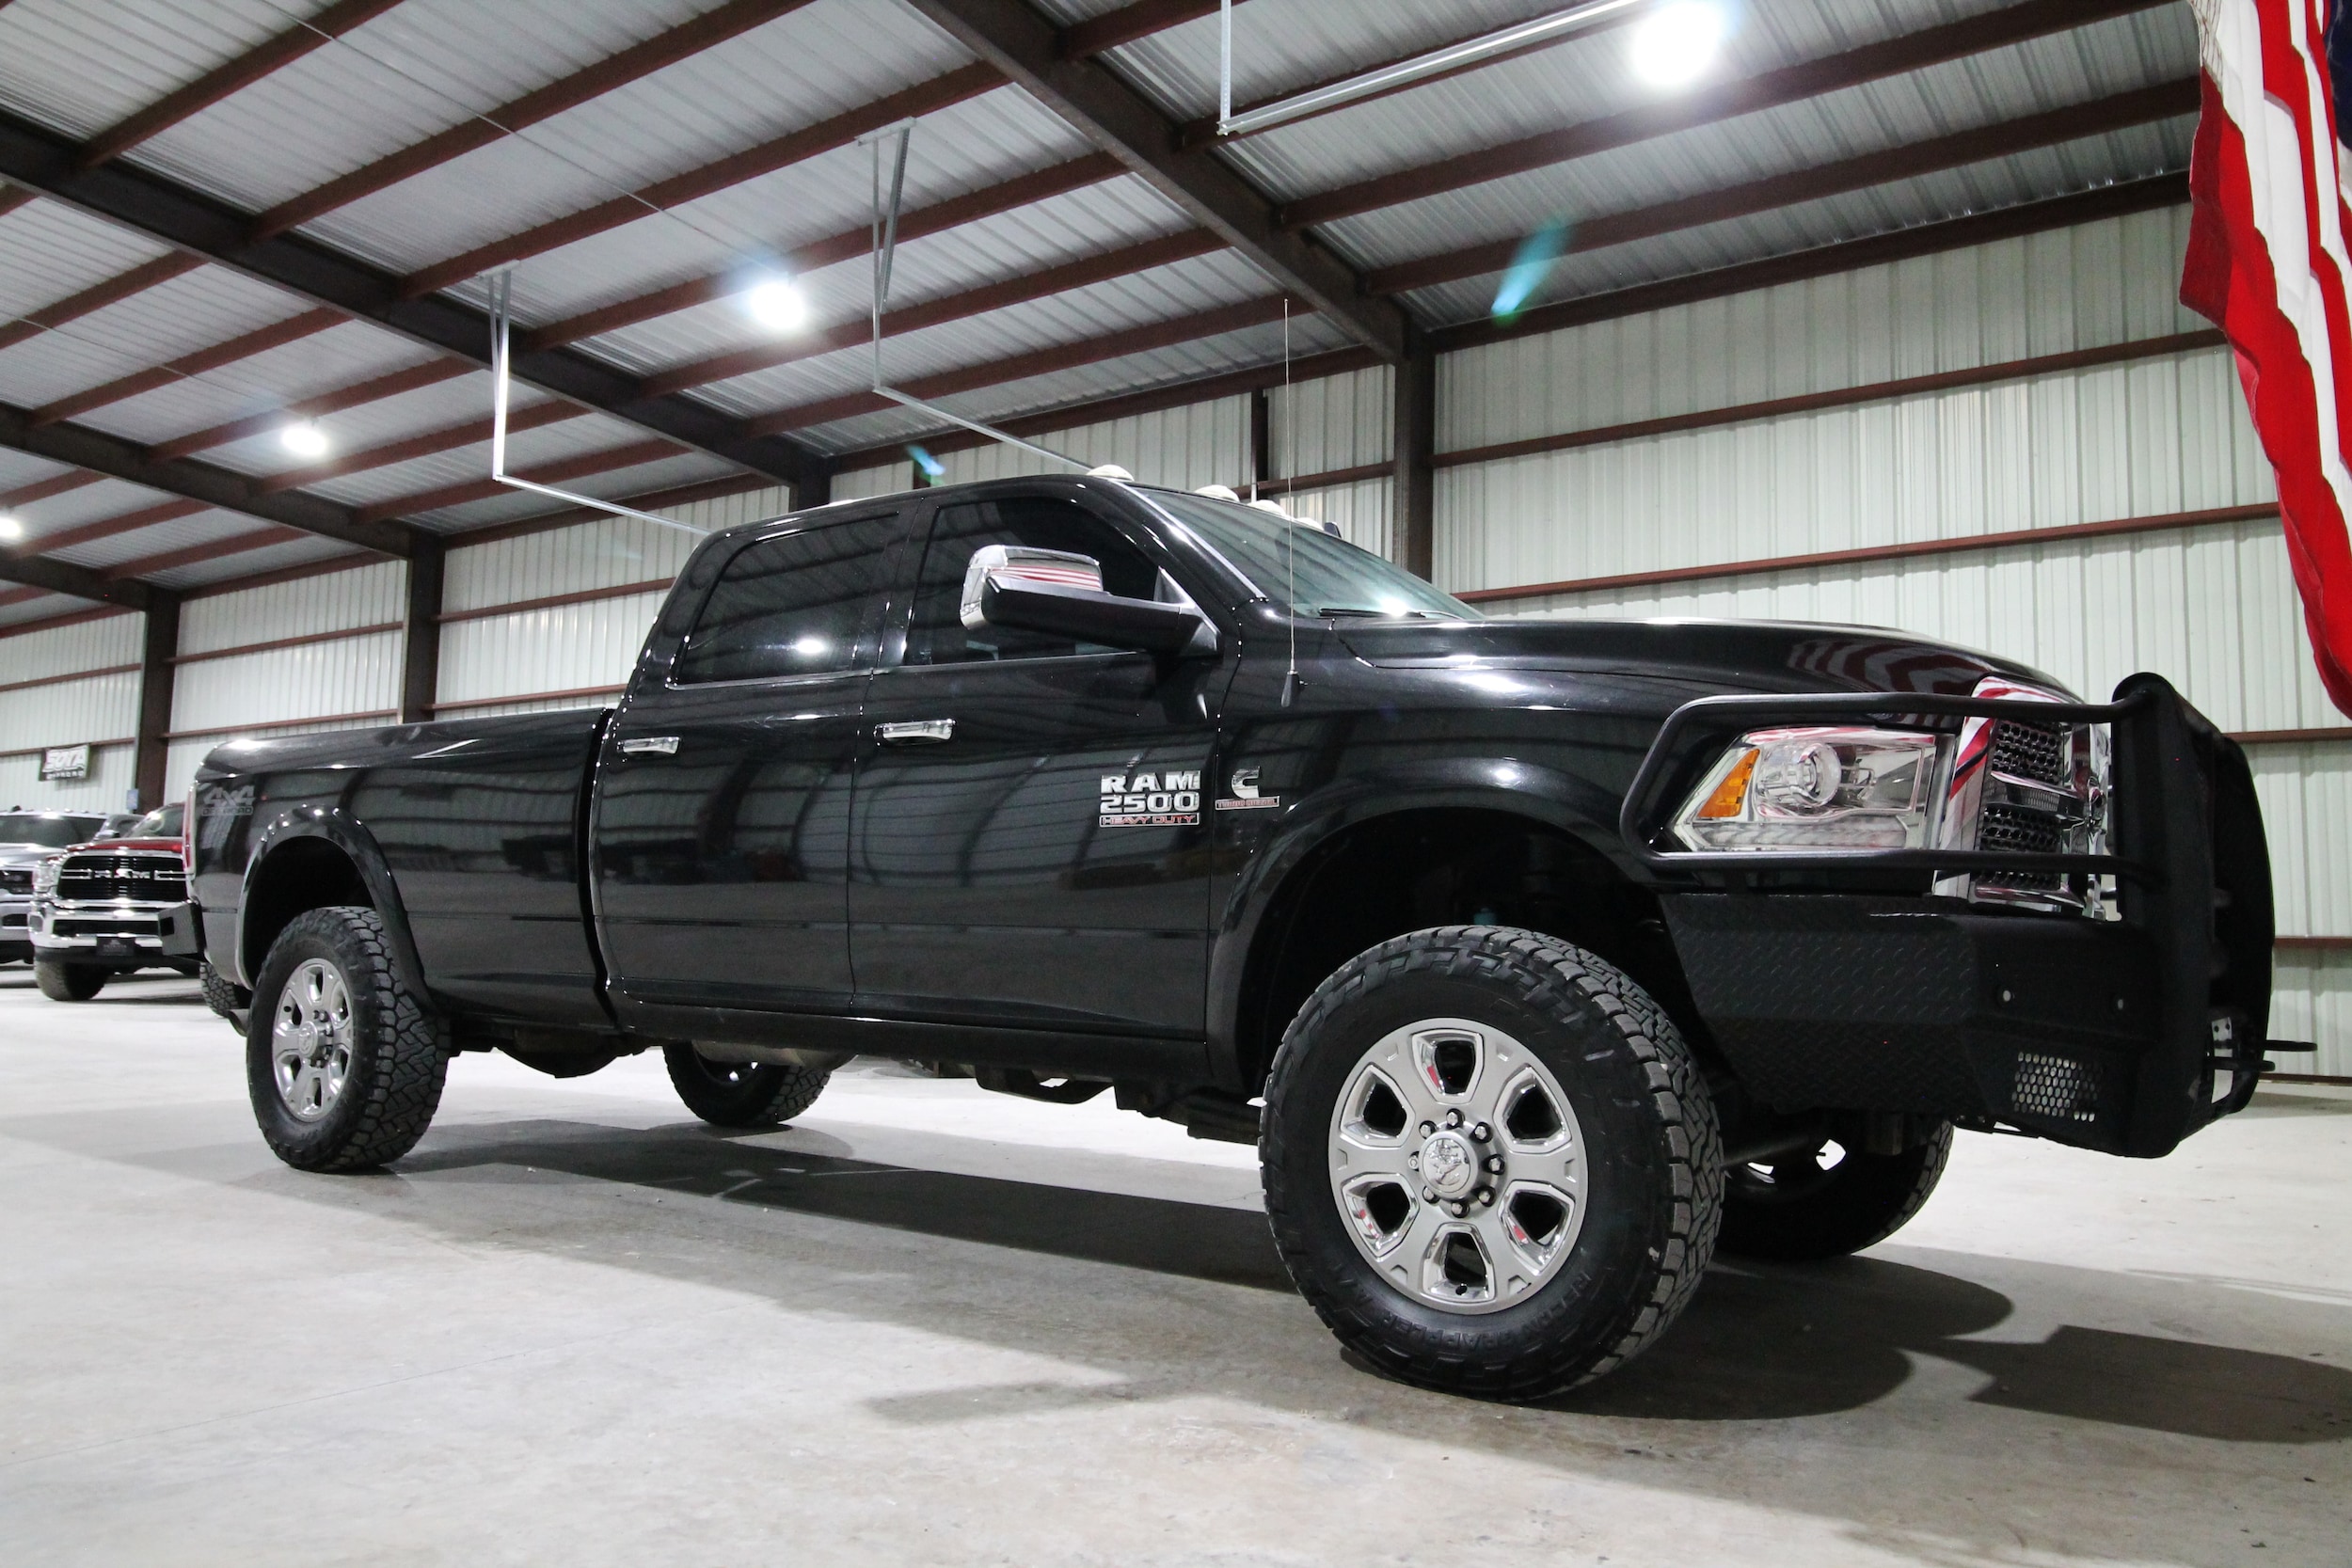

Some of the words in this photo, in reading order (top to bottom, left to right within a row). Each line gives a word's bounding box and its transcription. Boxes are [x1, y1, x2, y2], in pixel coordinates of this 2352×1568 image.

[43, 749, 87, 771] SOTA
[1101, 770, 1201, 793] RAM
[1100, 791, 1200, 814] 2500
[1102, 816, 1152, 825] HEAVY
[1152, 815, 1196, 824] DUTY
[94, 868, 151, 879] RAM
